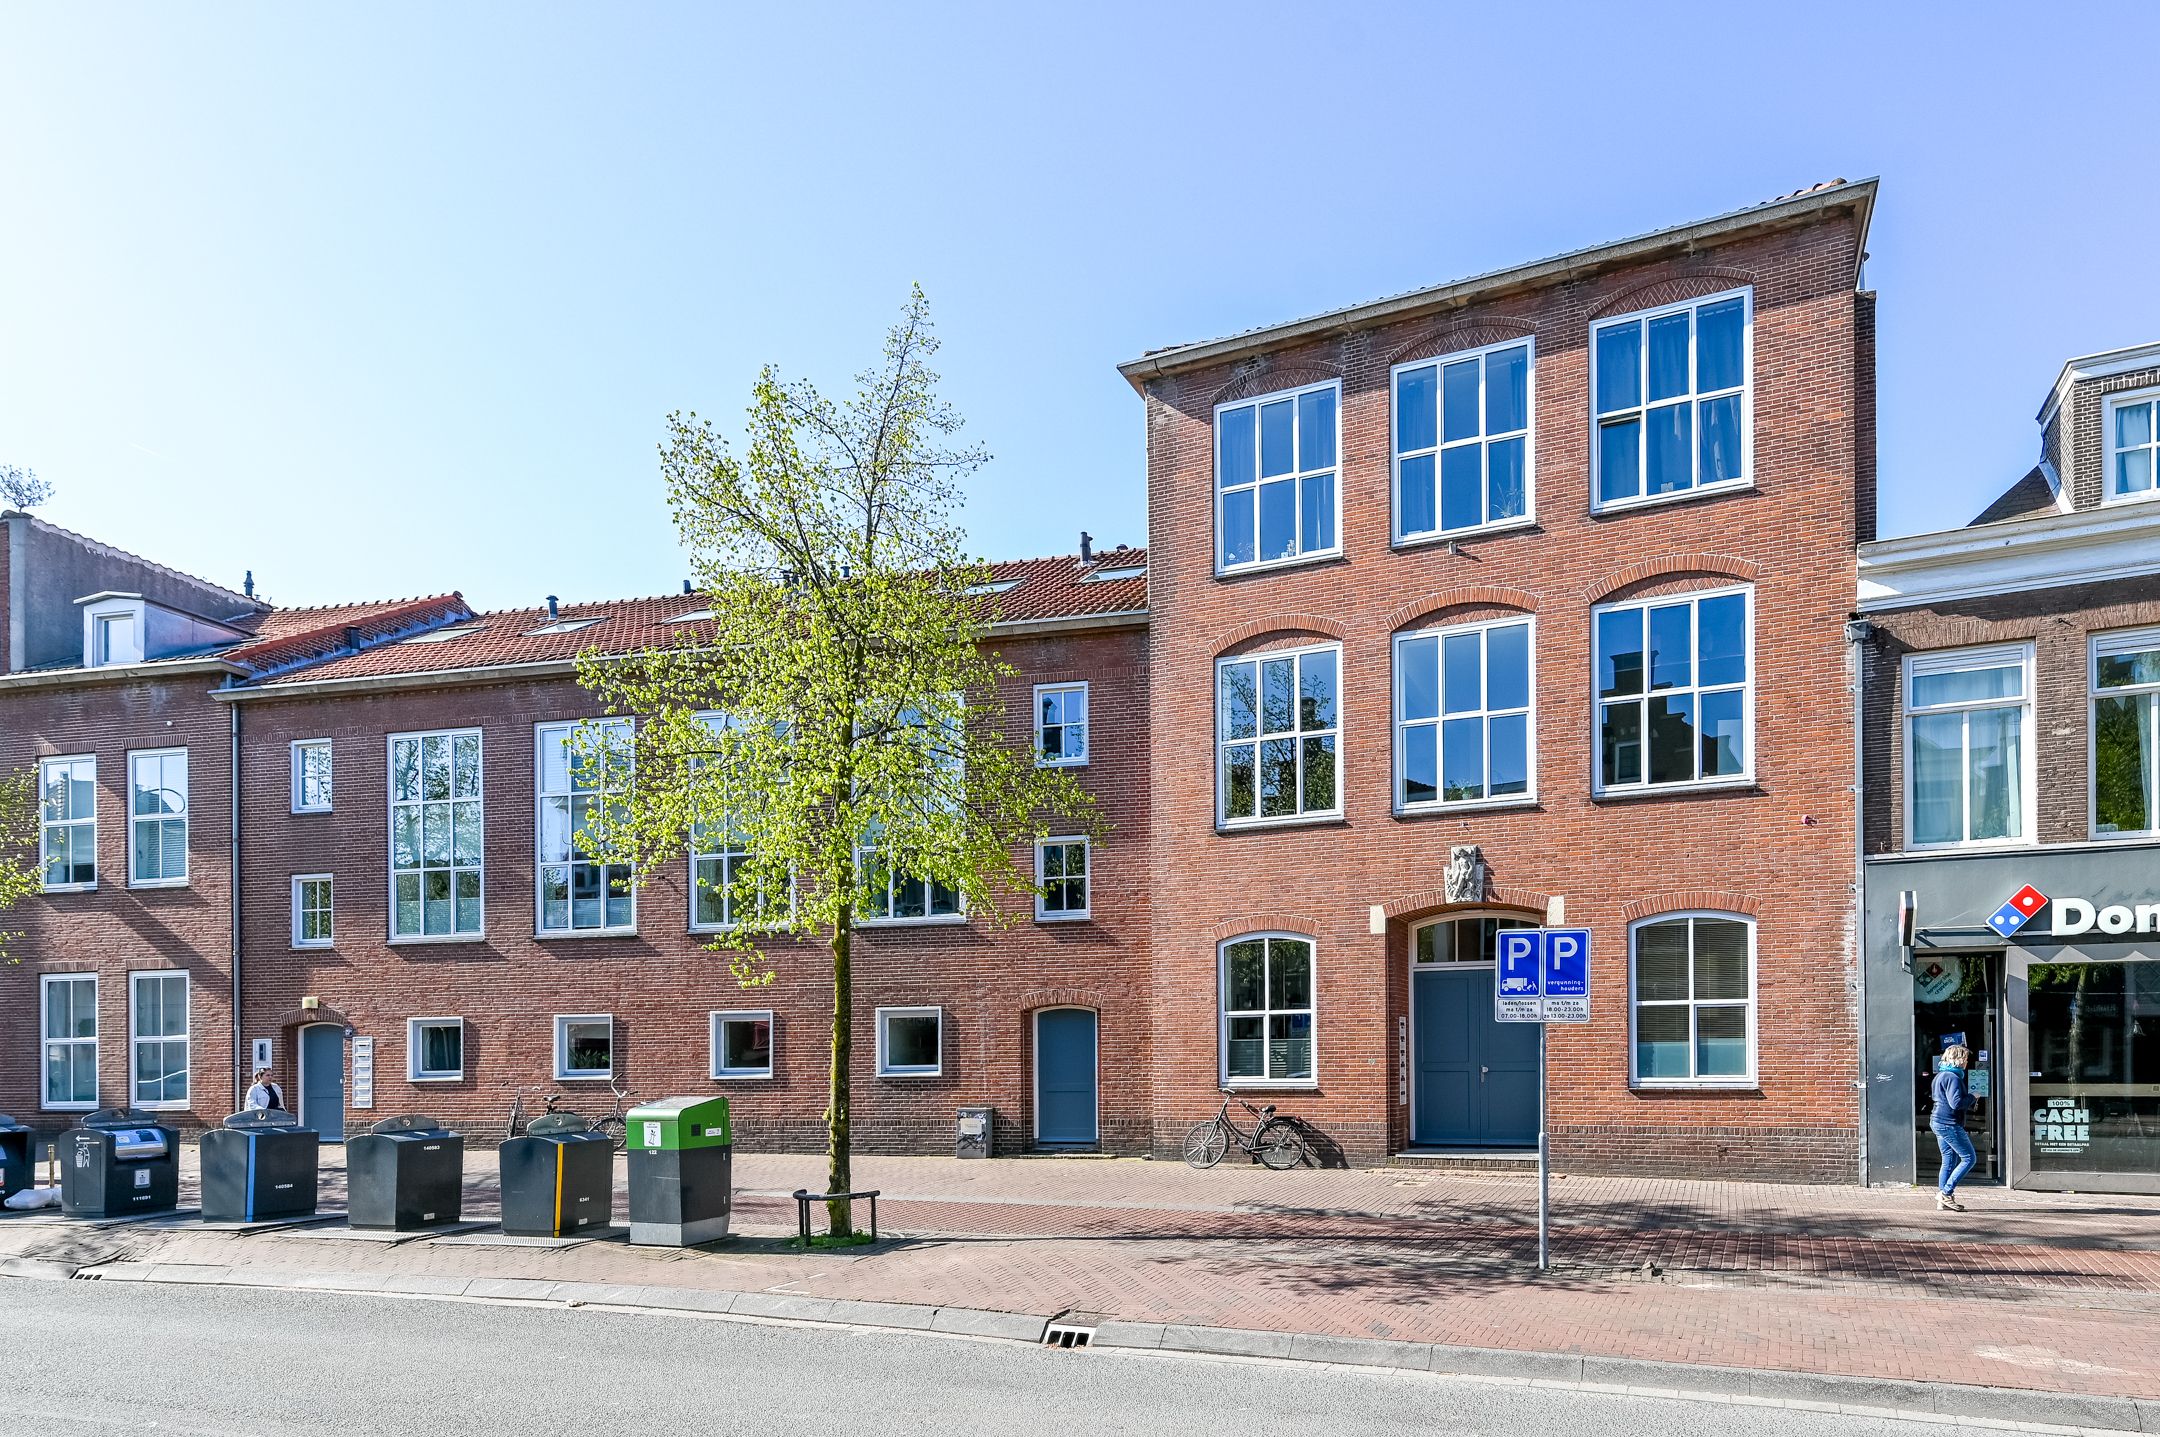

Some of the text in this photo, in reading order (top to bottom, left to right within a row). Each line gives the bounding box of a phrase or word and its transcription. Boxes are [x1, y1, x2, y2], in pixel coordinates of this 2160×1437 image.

[1508, 937, 1531, 970] P
[1554, 937, 1578, 970] P
[2034, 1108, 2089, 1123] CASH
[2035, 1125, 2089, 1141] FREE
